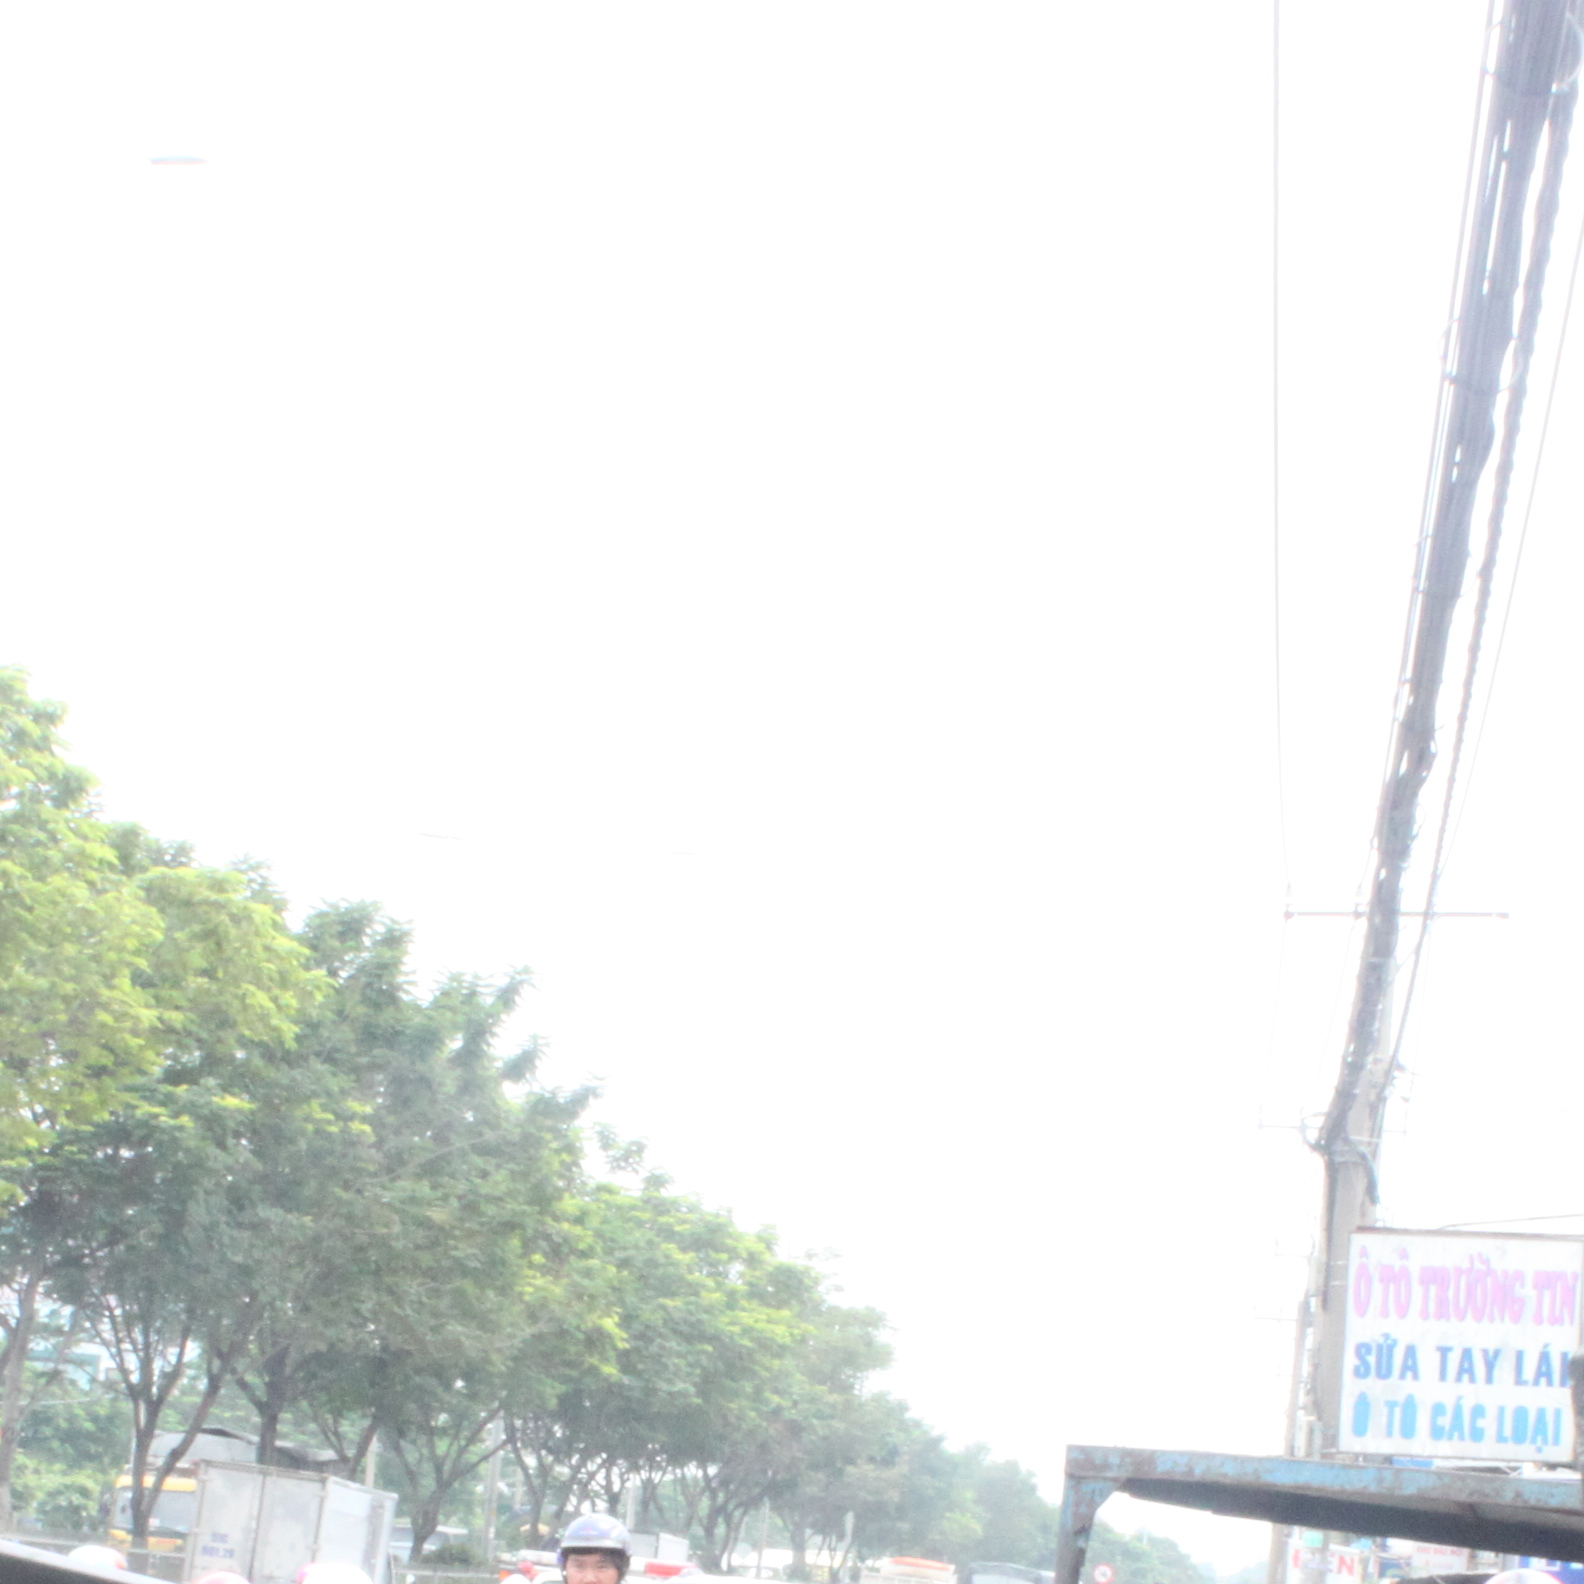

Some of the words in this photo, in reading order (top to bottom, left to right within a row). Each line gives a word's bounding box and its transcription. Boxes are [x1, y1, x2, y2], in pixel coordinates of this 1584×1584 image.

[1353, 1244, 1372, 1319] Ô
[1378, 1247, 1412, 1321] TÔ
[1353, 1332, 1420, 1382] SỬA
[1436, 1345, 1502, 1385] TAY
[1352, 1391, 1372, 1438] Ô
[1385, 1393, 1418, 1440] TÔ
[1430, 1395, 1487, 1444] CÁC
[1495, 1405, 1563, 1455] LOẠI
